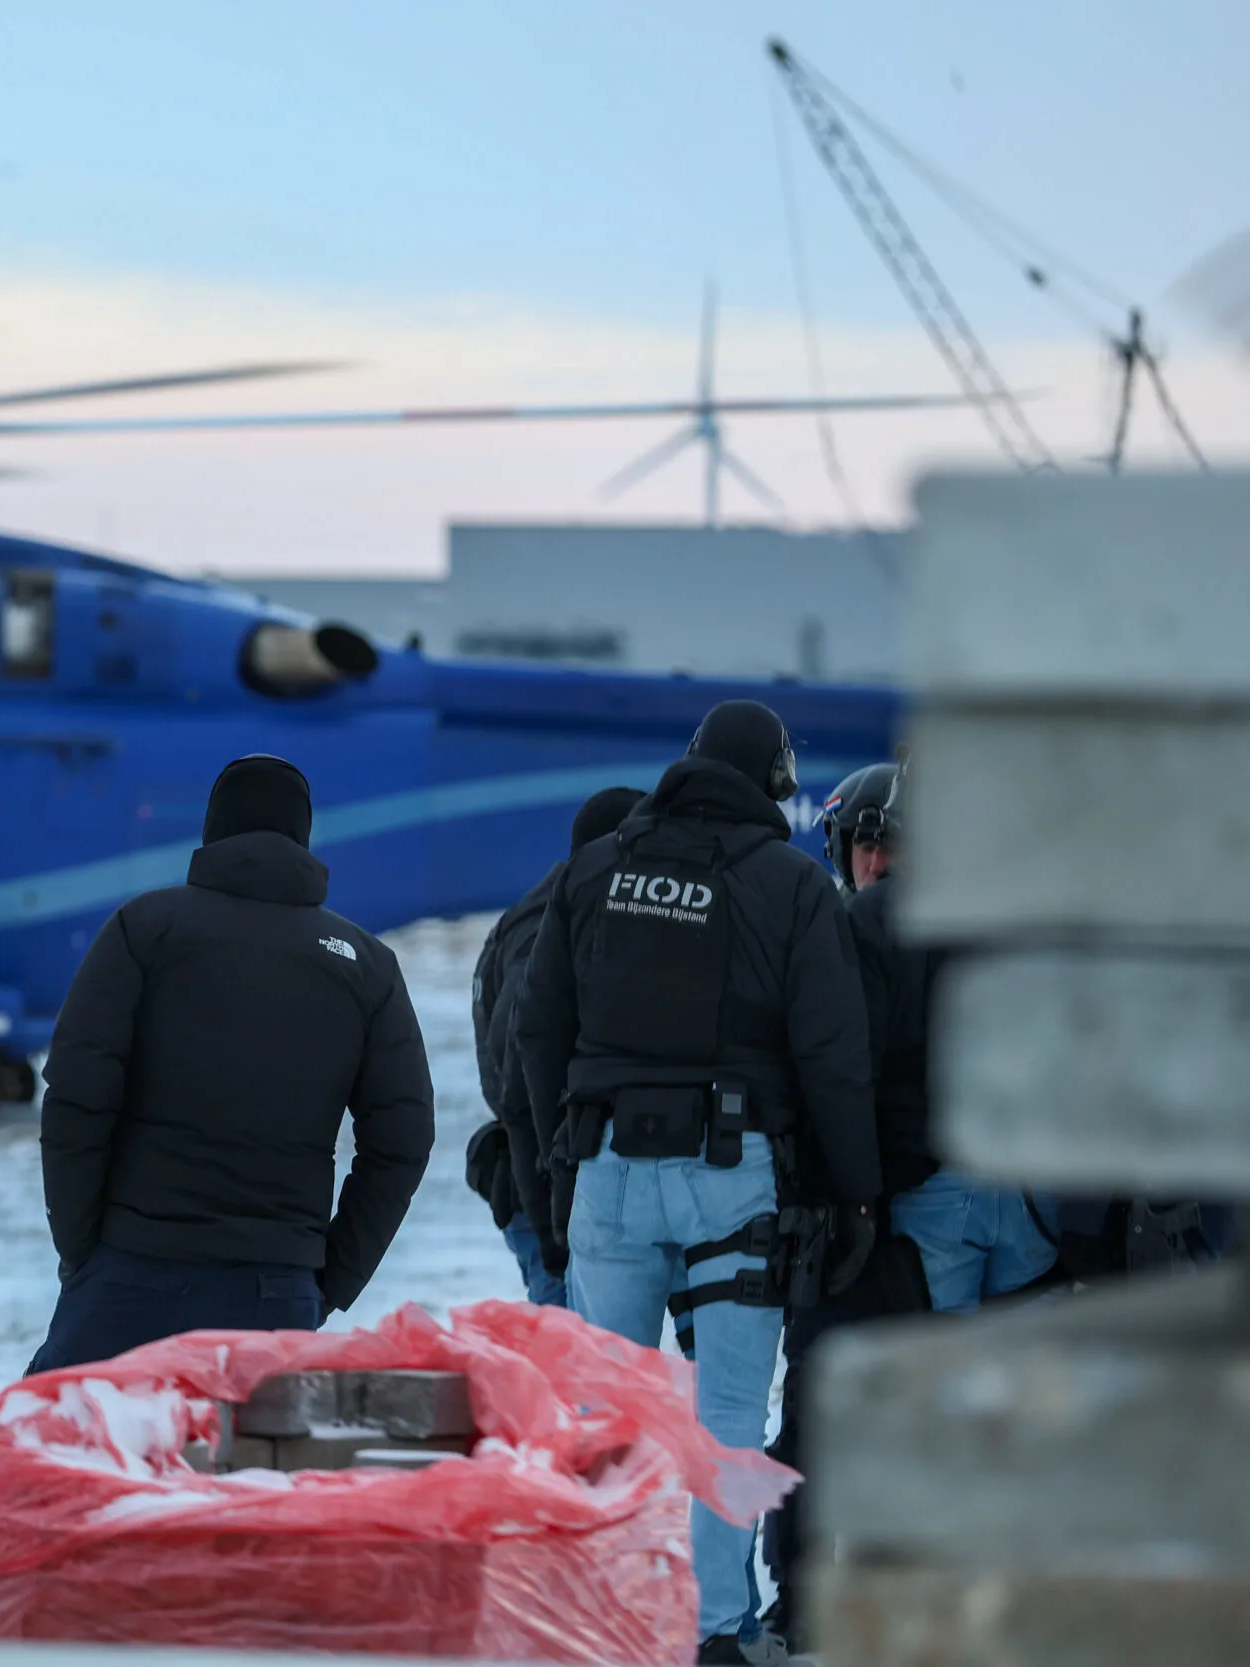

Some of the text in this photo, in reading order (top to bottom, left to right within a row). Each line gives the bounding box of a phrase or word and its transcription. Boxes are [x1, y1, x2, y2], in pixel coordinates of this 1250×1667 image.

[609, 873, 712, 908] FIOD
[607, 899, 708, 923] Team Bijzondere Bijstand
[329, 936, 343, 944] THE
